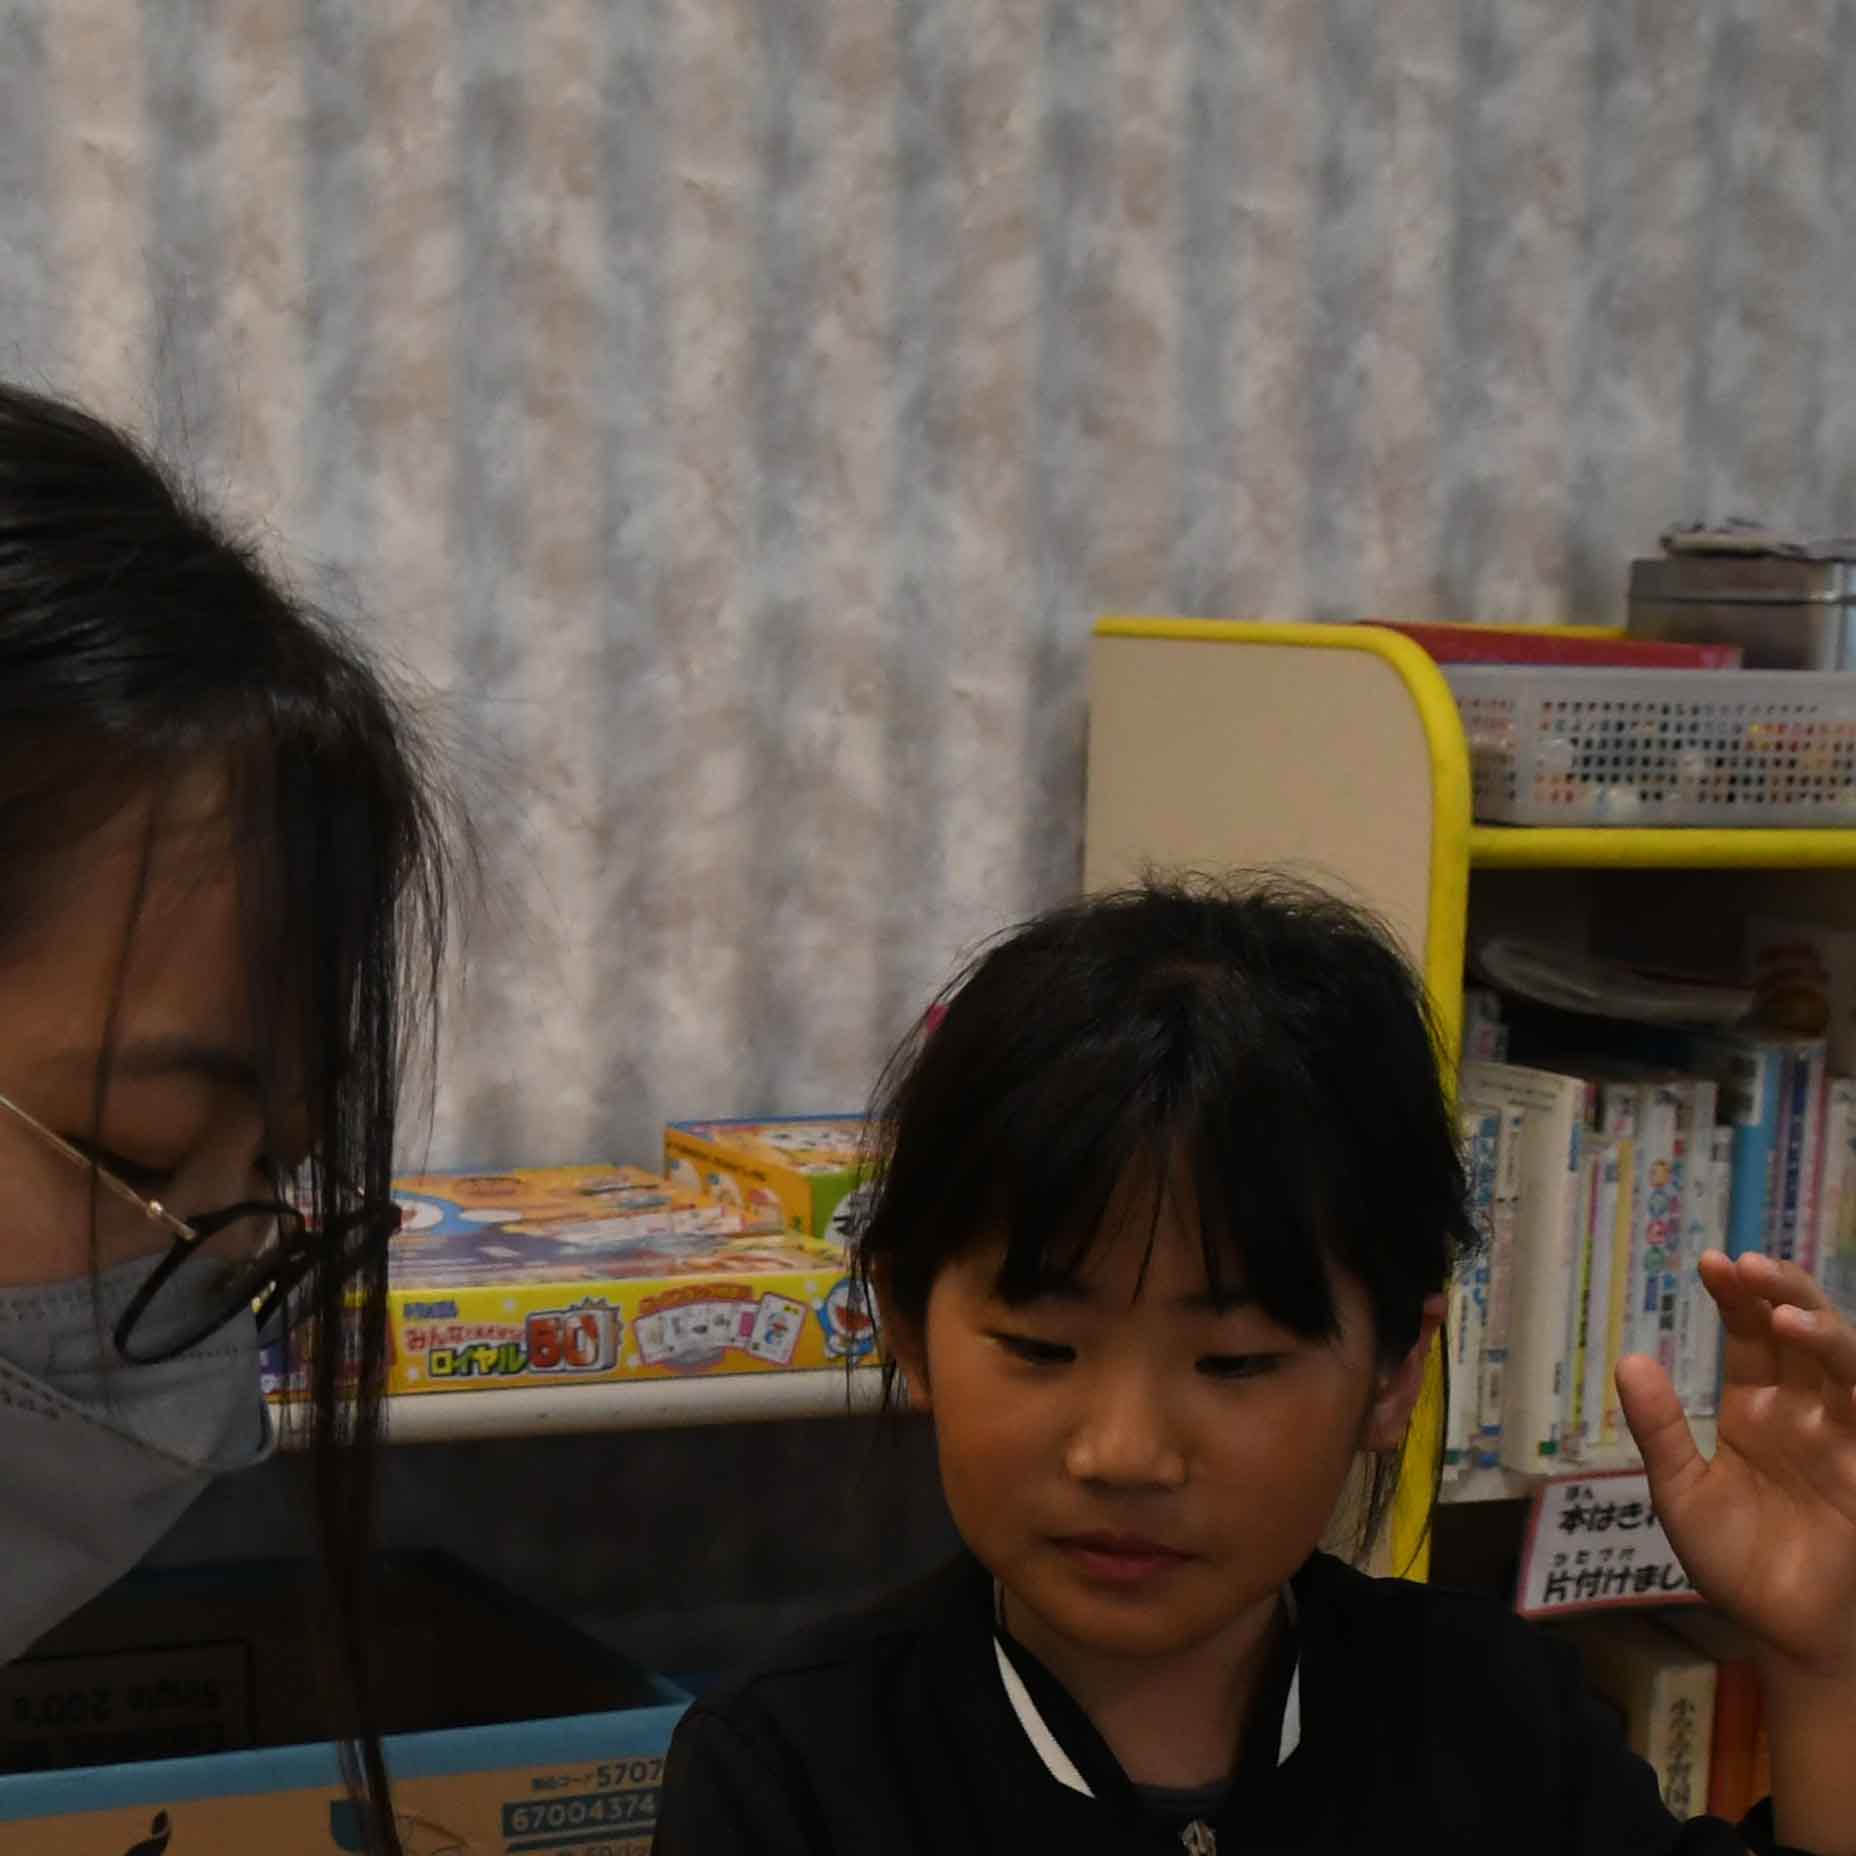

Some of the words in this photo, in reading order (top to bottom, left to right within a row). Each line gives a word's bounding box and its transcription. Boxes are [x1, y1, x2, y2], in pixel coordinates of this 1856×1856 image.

[1543, 1562, 1697, 1604] 片付けまし
[512, 1792, 656, 1832] 67004374
